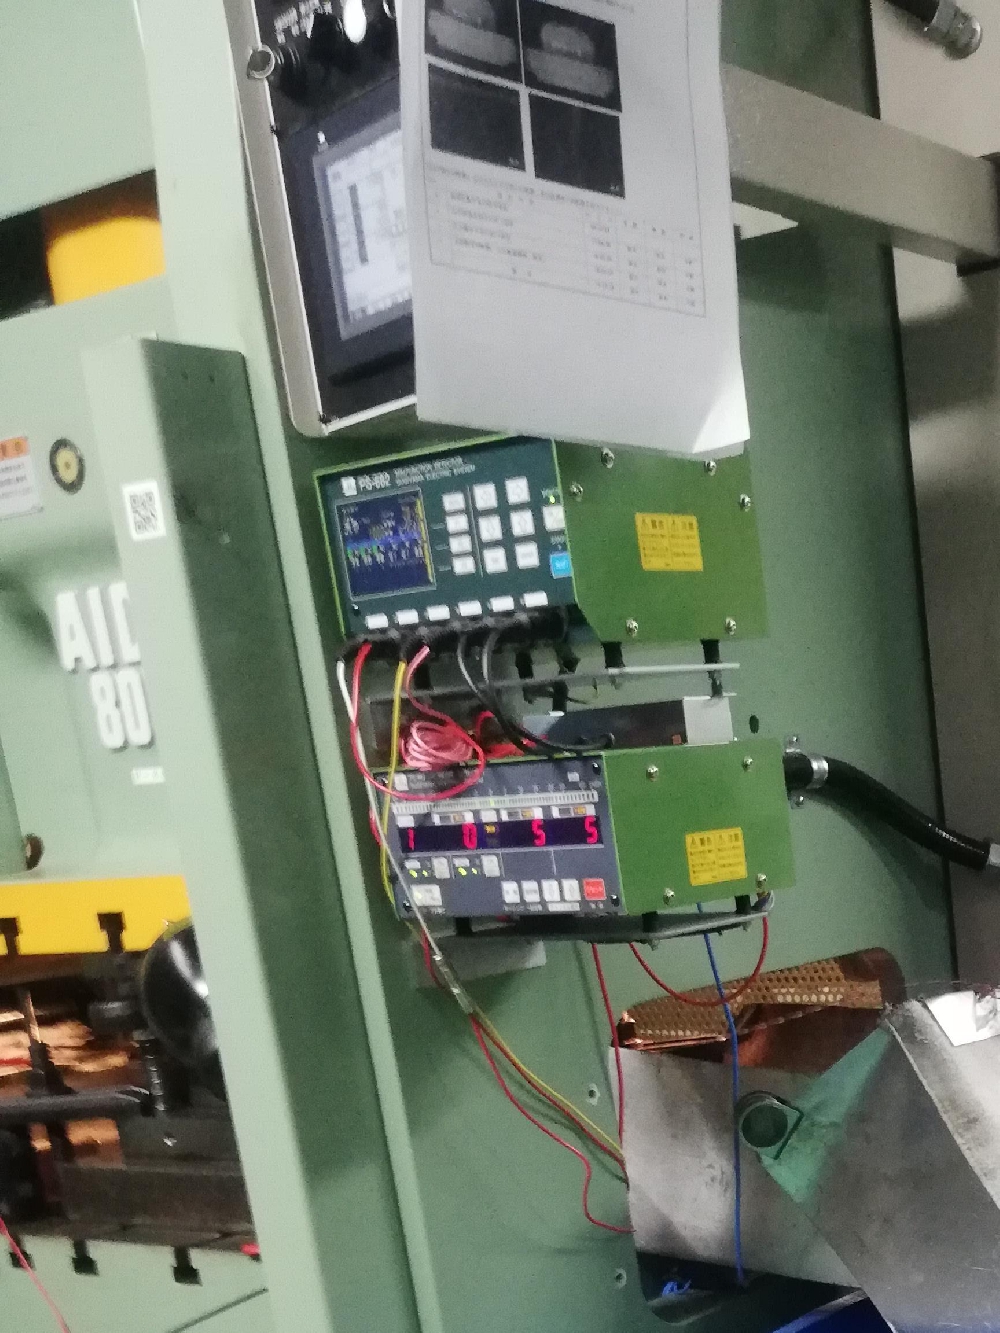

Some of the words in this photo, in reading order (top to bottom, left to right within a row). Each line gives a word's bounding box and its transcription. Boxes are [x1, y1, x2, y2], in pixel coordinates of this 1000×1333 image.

[89, 666, 153, 750] 80
[407, 827, 415, 851] 1
[461, 822, 478, 851] 0
[531, 818, 546, 847] 5
[584, 815, 599, 845] 5
